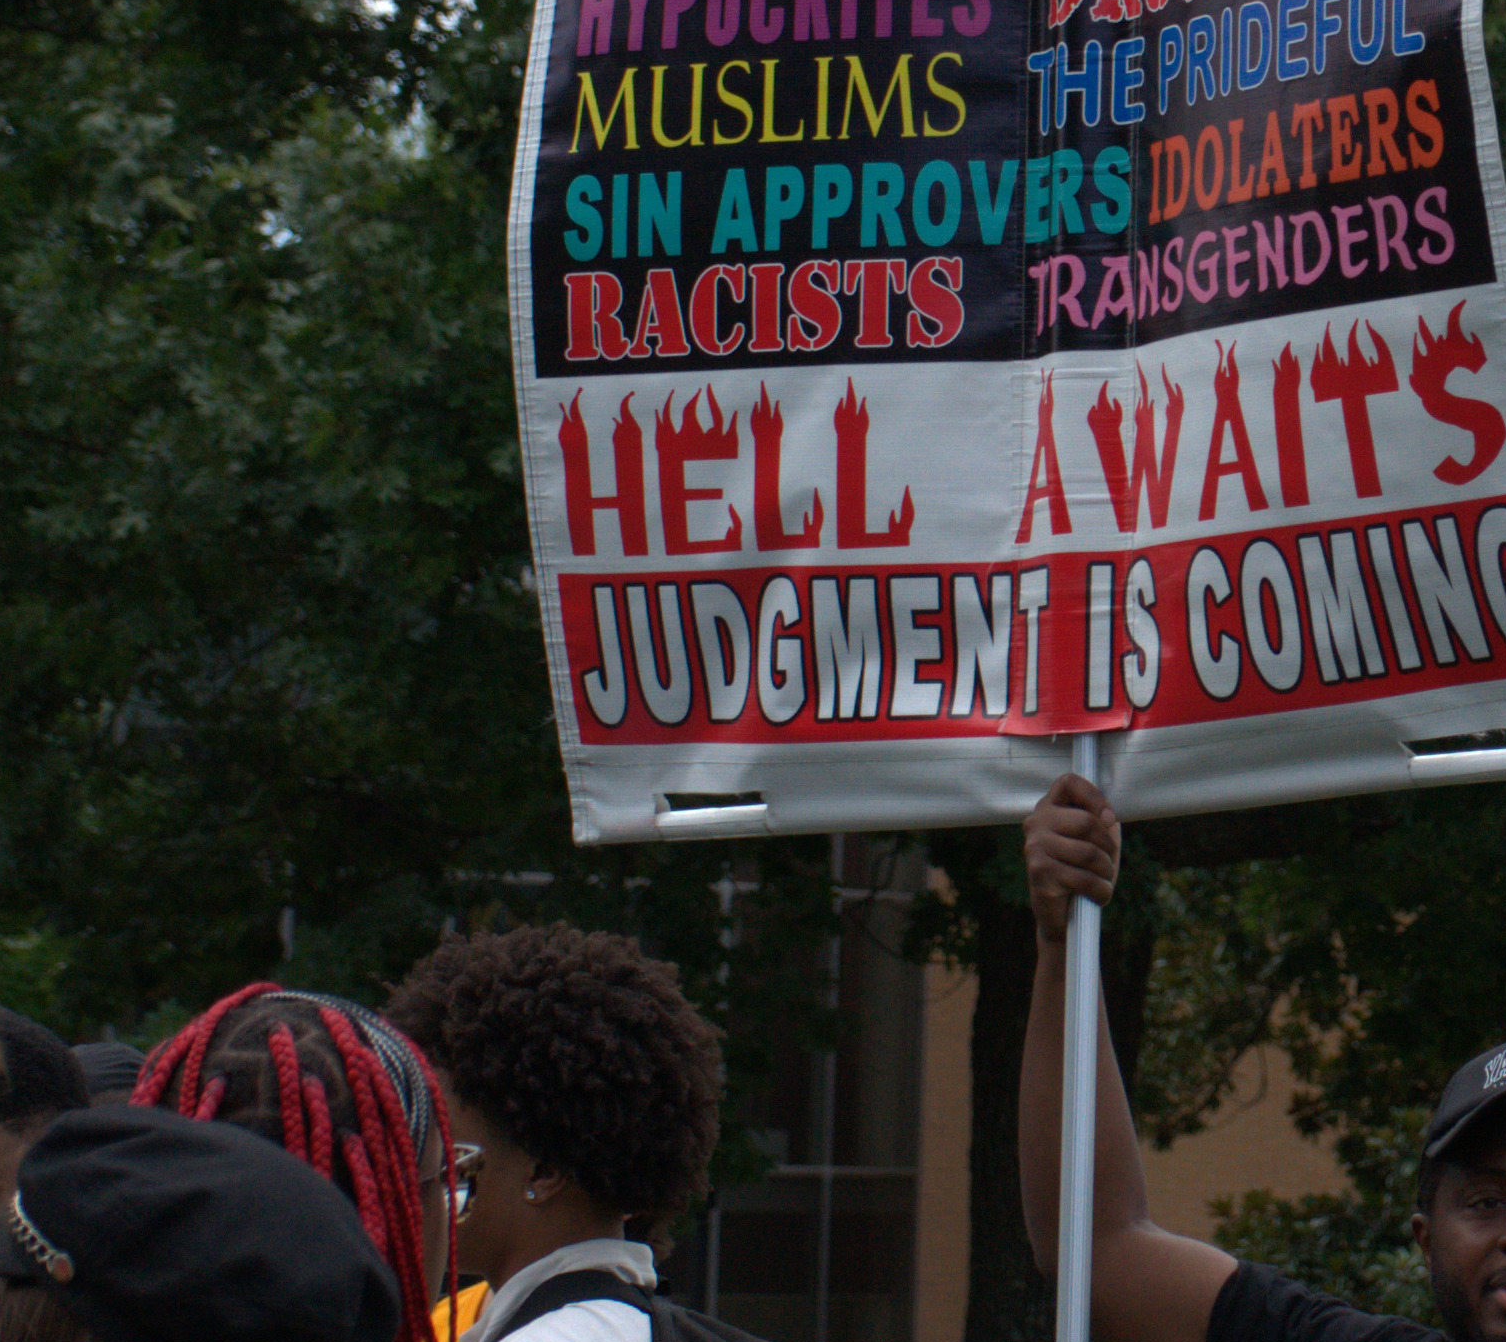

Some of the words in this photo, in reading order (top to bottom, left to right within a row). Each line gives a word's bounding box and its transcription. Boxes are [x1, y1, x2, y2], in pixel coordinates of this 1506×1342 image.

[569, 53, 967, 154] MUSLIMS
[1027, 39, 1147, 135] THE
[563, 170, 682, 260] SIN
[710, 145, 1132, 254] APPROVERS
[1149, 79, 1444, 227] IDOLATERS
[563, 256, 964, 362] RACISTS
[1027, 186, 1456, 336] TRANSGENDERS
[556, 374, 915, 557] HELL
[582, 566, 1049, 728] JUDGMENT
[1085, 561, 1157, 711] IS
